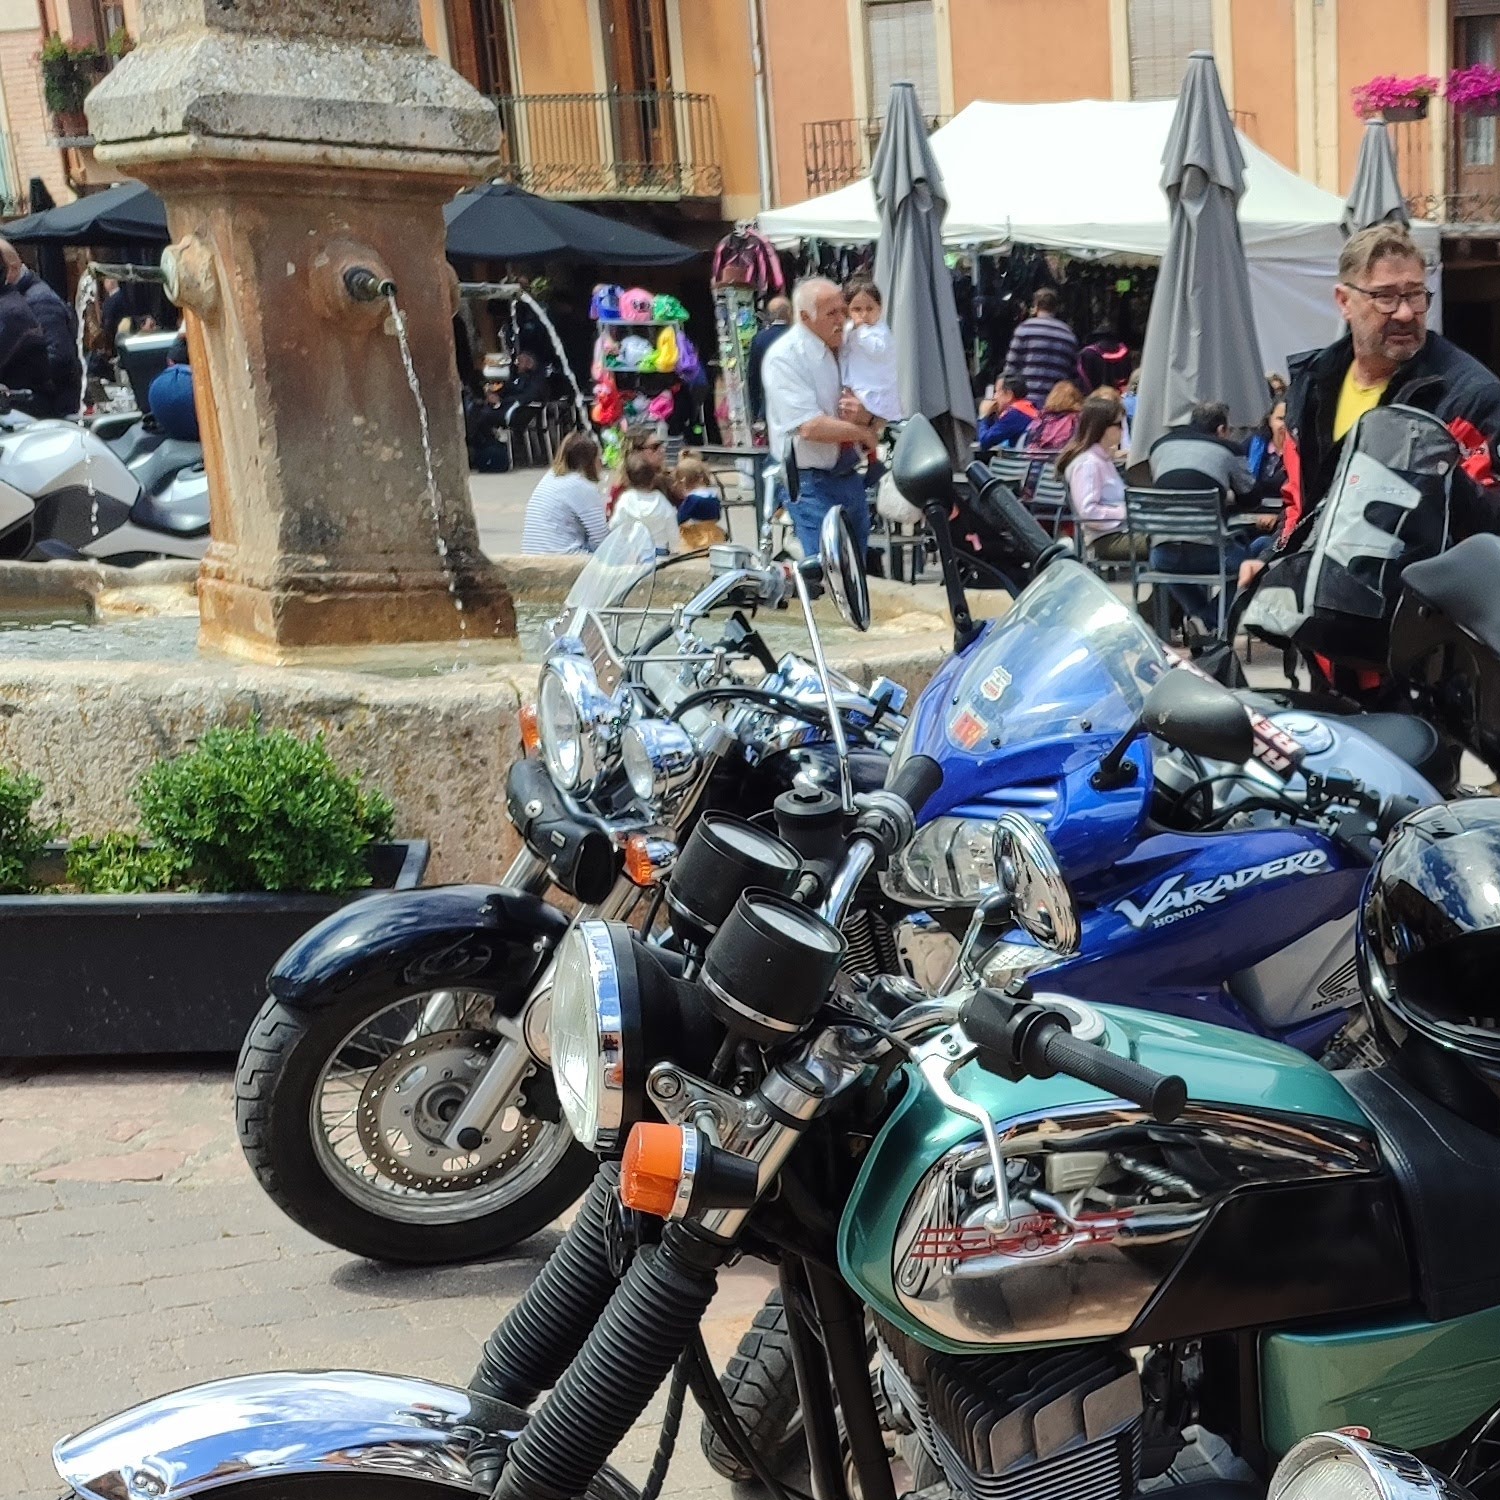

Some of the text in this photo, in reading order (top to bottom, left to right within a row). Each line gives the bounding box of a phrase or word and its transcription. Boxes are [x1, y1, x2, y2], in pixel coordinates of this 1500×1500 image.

[1114, 848, 1330, 929] VARADERO
[1153, 903, 1206, 930] HONDA
[1311, 986, 1361, 1011] HOND
